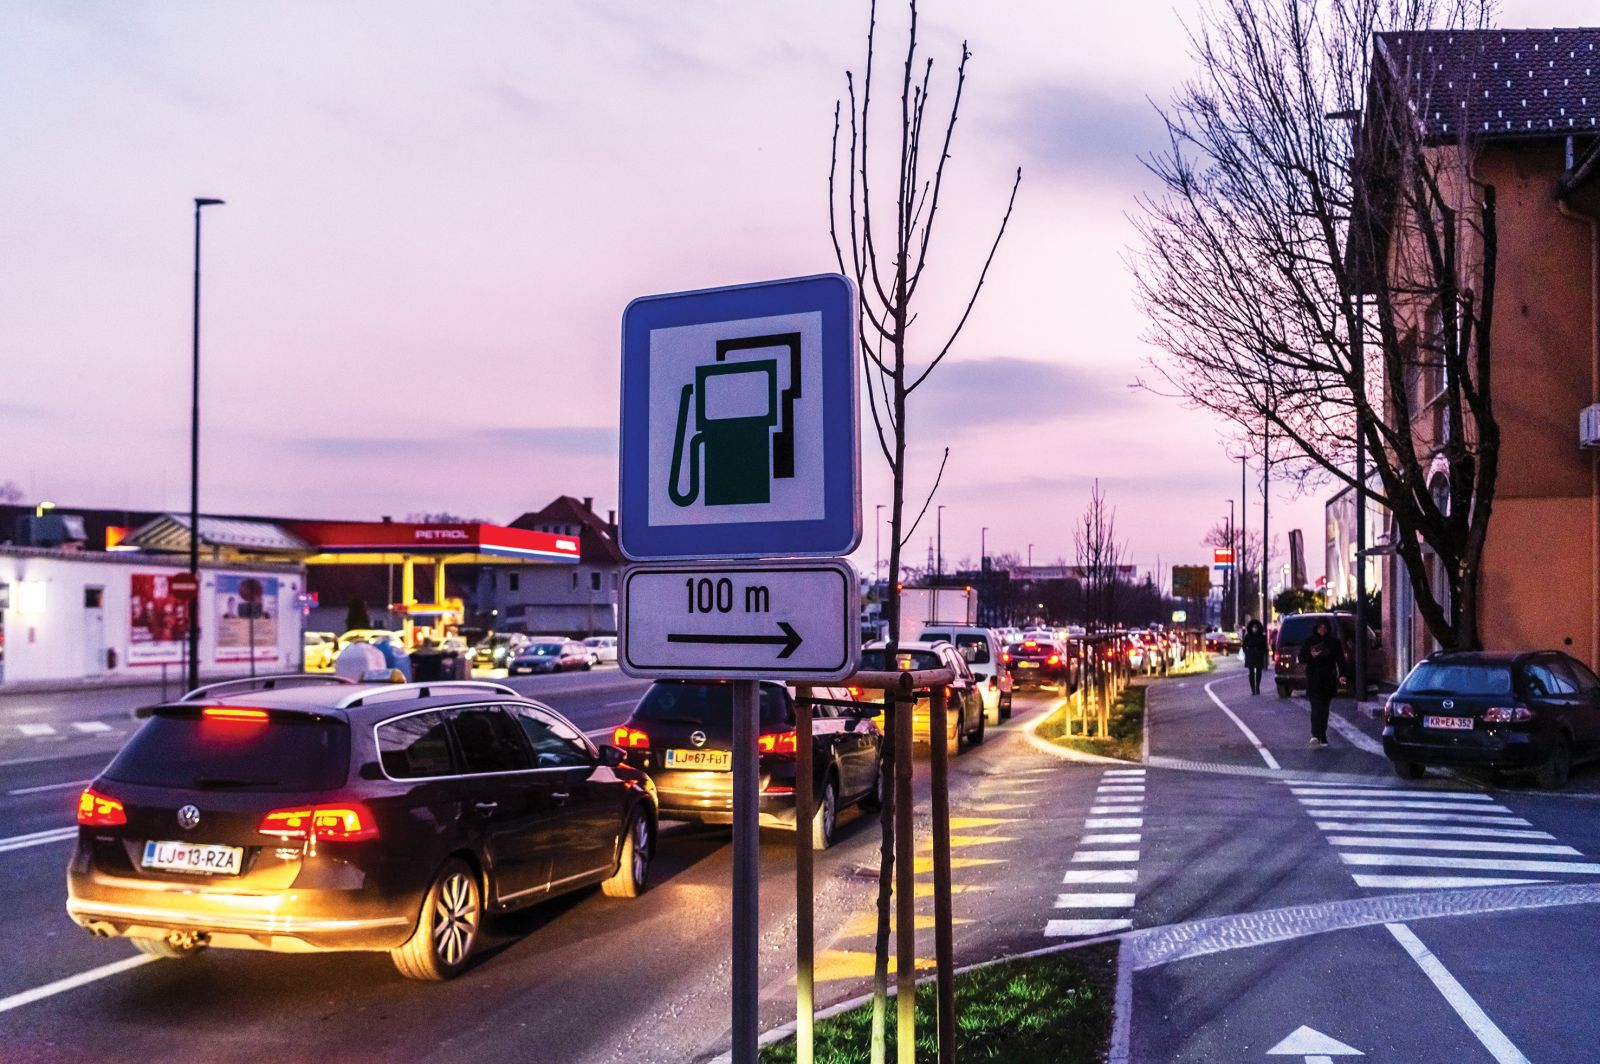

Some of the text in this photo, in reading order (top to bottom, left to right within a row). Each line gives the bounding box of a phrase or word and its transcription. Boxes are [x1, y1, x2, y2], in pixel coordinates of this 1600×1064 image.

[415, 529, 469, 539] PETROL
[685, 577, 769, 613] 100 m
